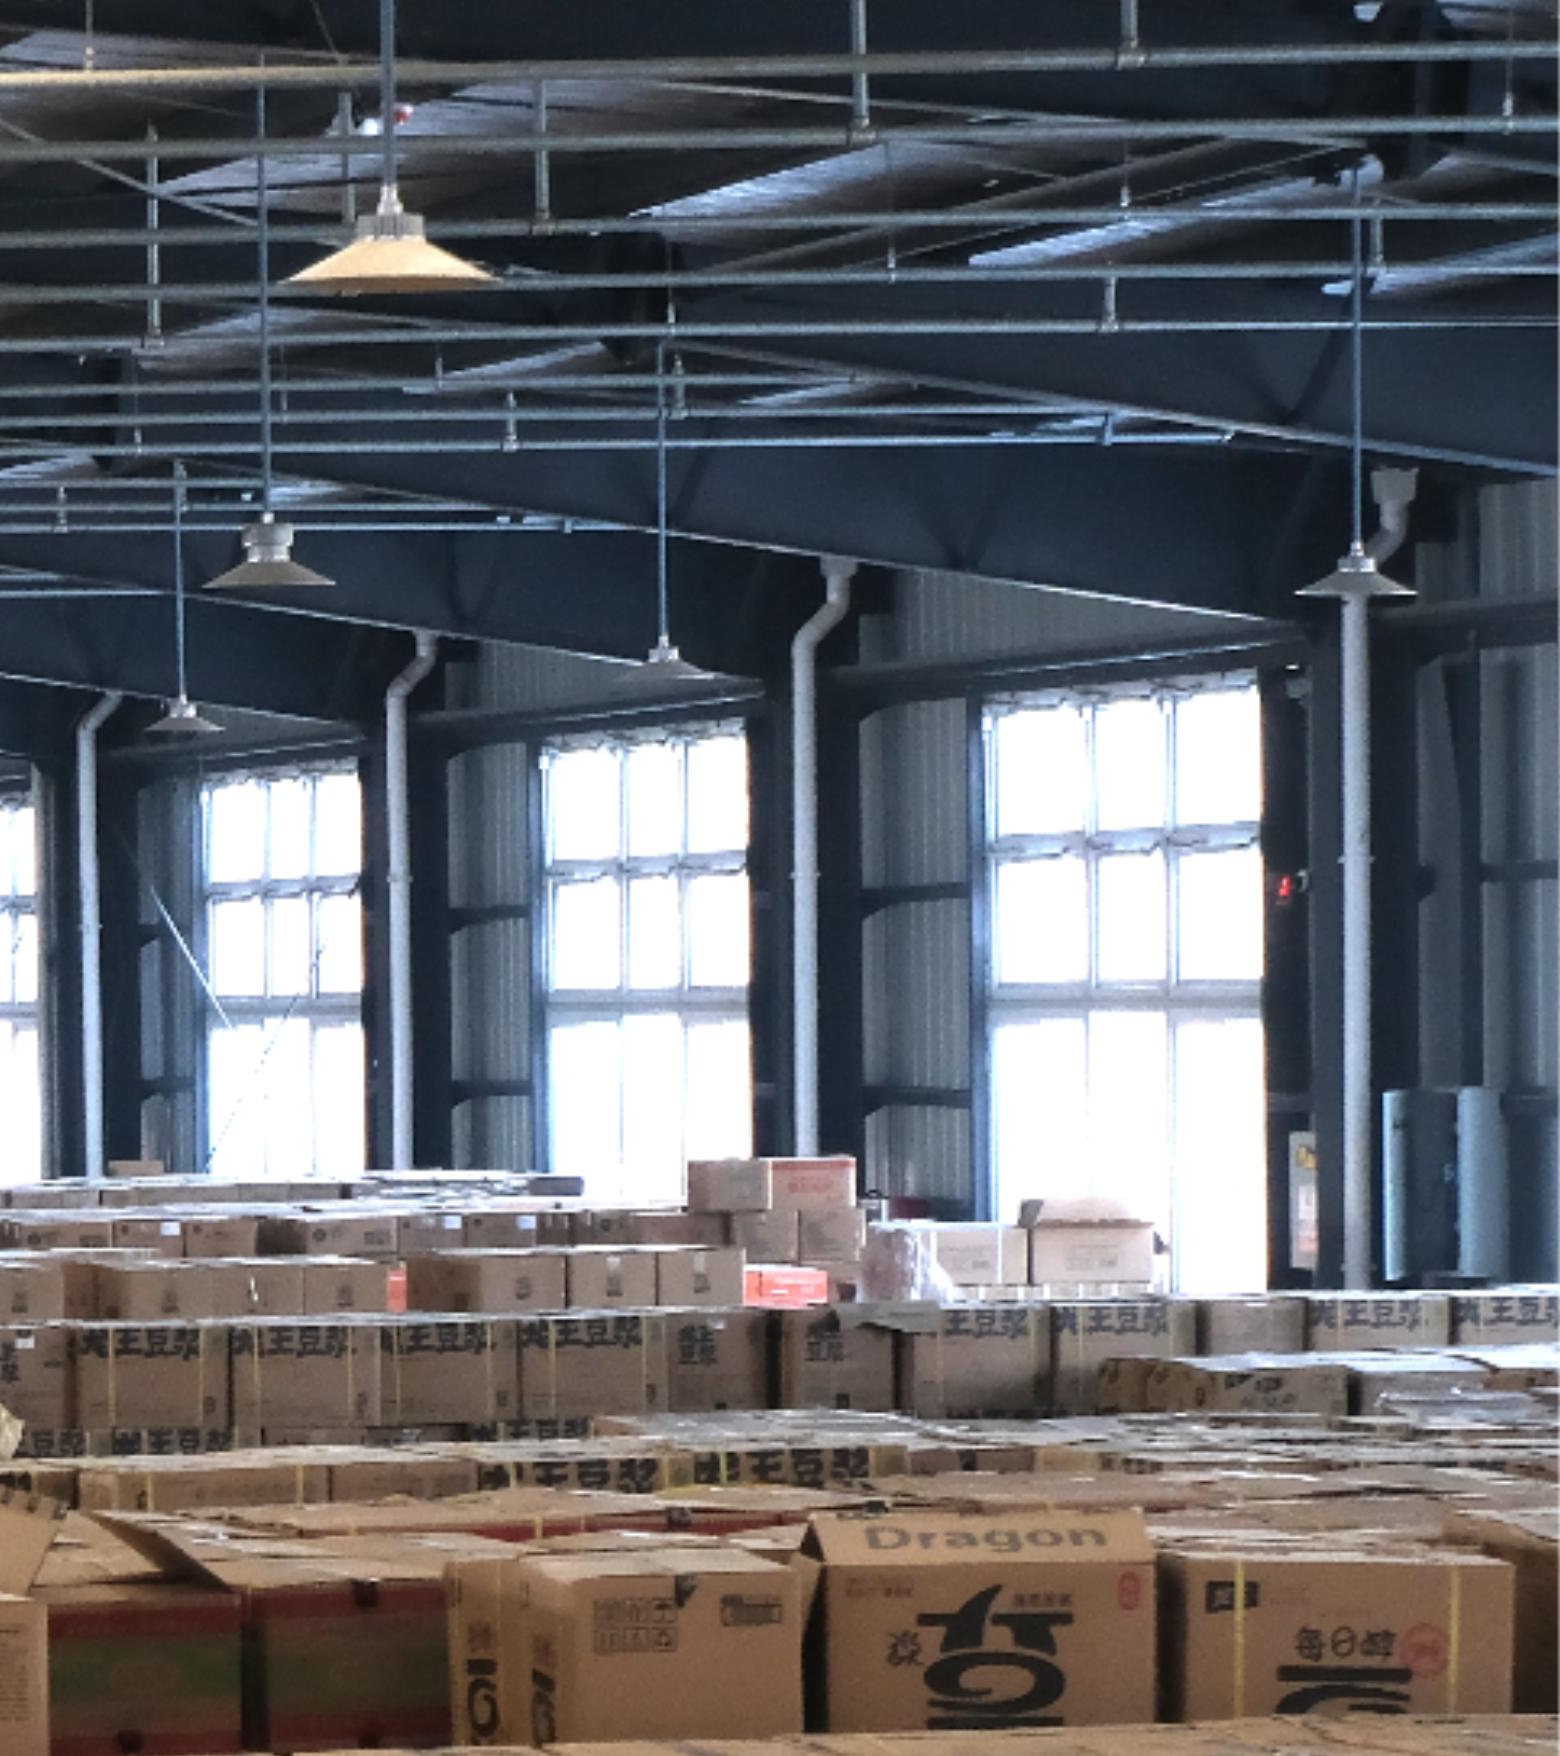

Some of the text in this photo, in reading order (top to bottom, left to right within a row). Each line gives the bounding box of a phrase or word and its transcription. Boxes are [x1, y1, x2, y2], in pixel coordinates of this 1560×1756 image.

[864, 1521, 1108, 1554] Dragon
[1293, 1625, 1400, 1663] 每日醇
